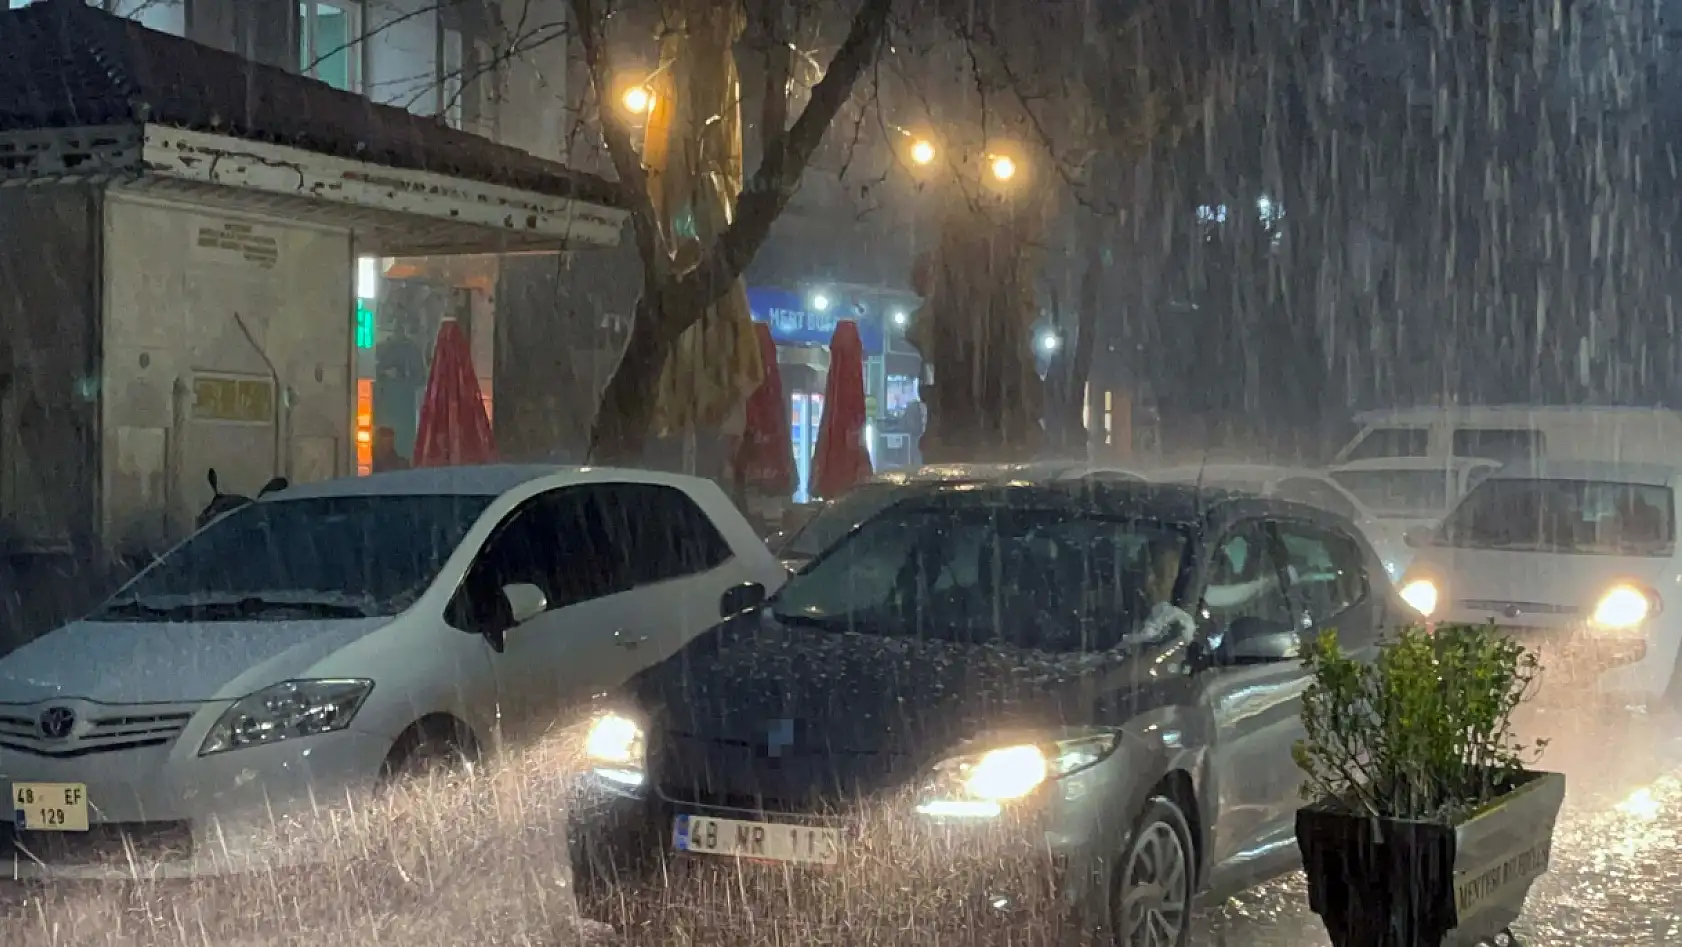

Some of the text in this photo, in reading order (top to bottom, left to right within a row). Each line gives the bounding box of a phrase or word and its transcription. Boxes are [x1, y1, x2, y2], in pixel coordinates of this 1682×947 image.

[17, 788, 81, 805] 48 EF
[40, 809, 65, 824] 129
[691, 819, 718, 849] 48
